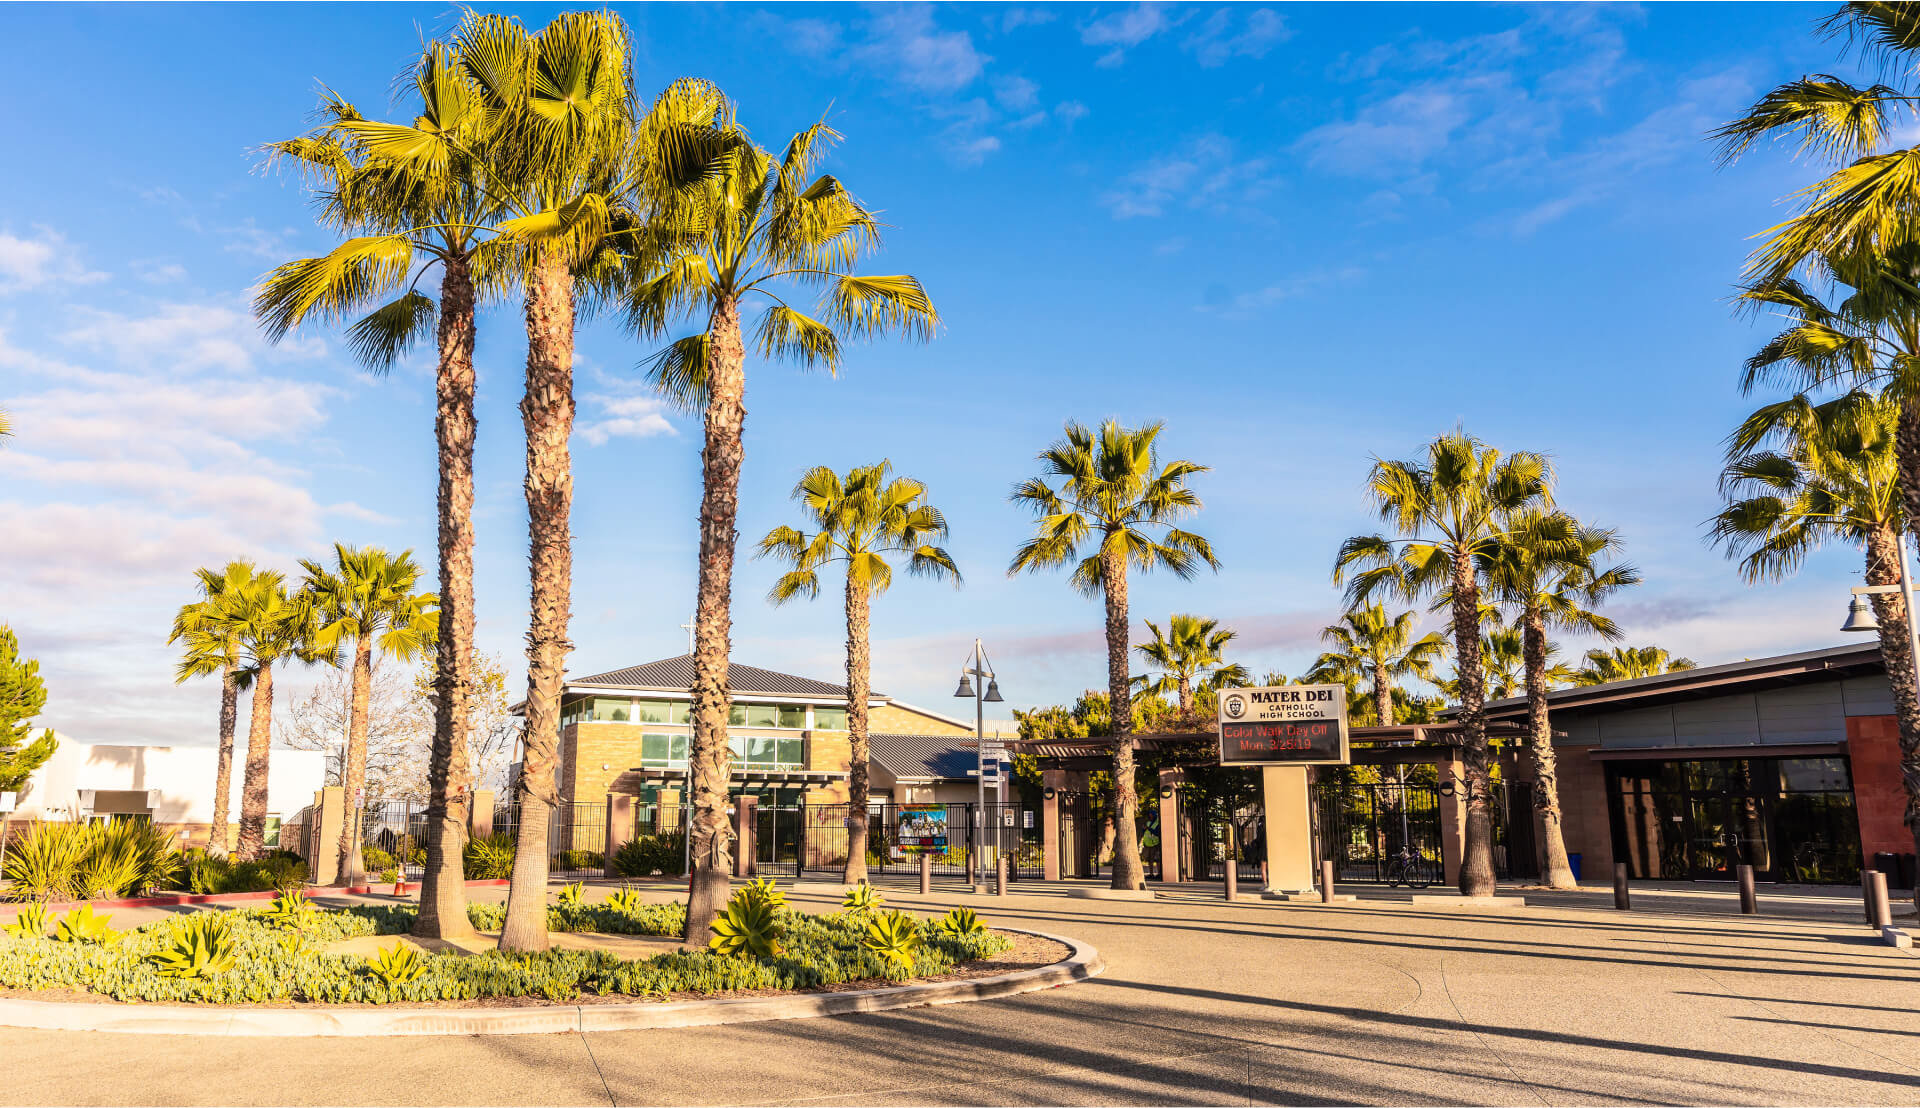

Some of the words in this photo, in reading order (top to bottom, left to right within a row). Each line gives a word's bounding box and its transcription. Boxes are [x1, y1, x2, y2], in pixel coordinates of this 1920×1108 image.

[1251, 691, 1301, 703] MATER
[1306, 690, 1333, 701] DEI
[1269, 704, 1315, 712] CATHOLIC
[1260, 711, 1283, 719] HIGH
[1287, 710, 1325, 718] SCHOOL
[1224, 726, 1253, 738] Color
[1255, 725, 1283, 737] Walk
[1287, 725, 1309, 739] Day
[1311, 724, 1328, 736] Off
[1270, 738, 1312, 750] 3/25/19
